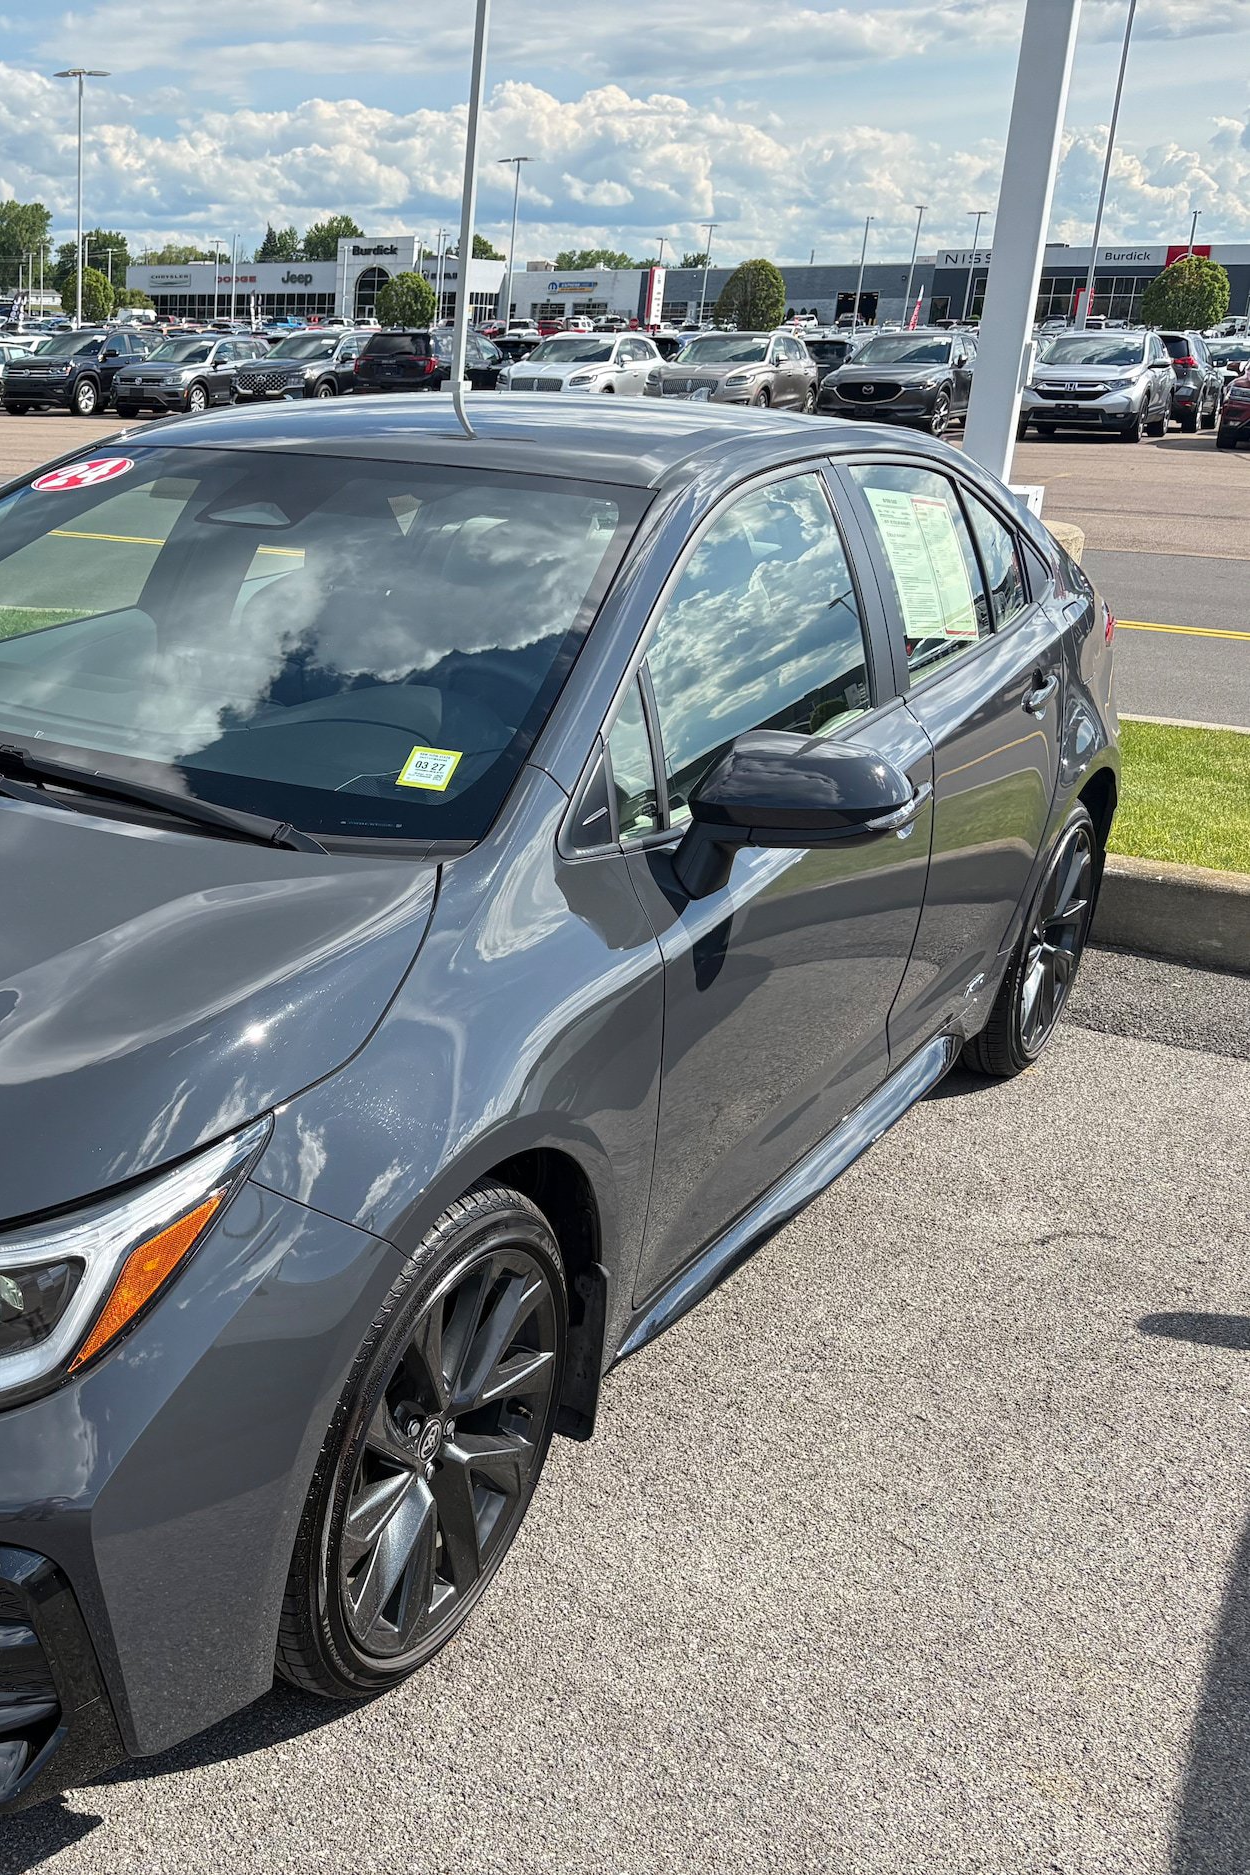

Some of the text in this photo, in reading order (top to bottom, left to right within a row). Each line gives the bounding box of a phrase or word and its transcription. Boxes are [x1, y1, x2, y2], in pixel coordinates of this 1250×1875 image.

[352, 244, 398, 256] Burdick
[945, 253, 991, 264] NISS
[1104, 251, 1151, 261] Burdick
[281, 270, 313, 286] Jeep
[38, 459, 128, 489] 24
[415, 760, 446, 771] 03 27
